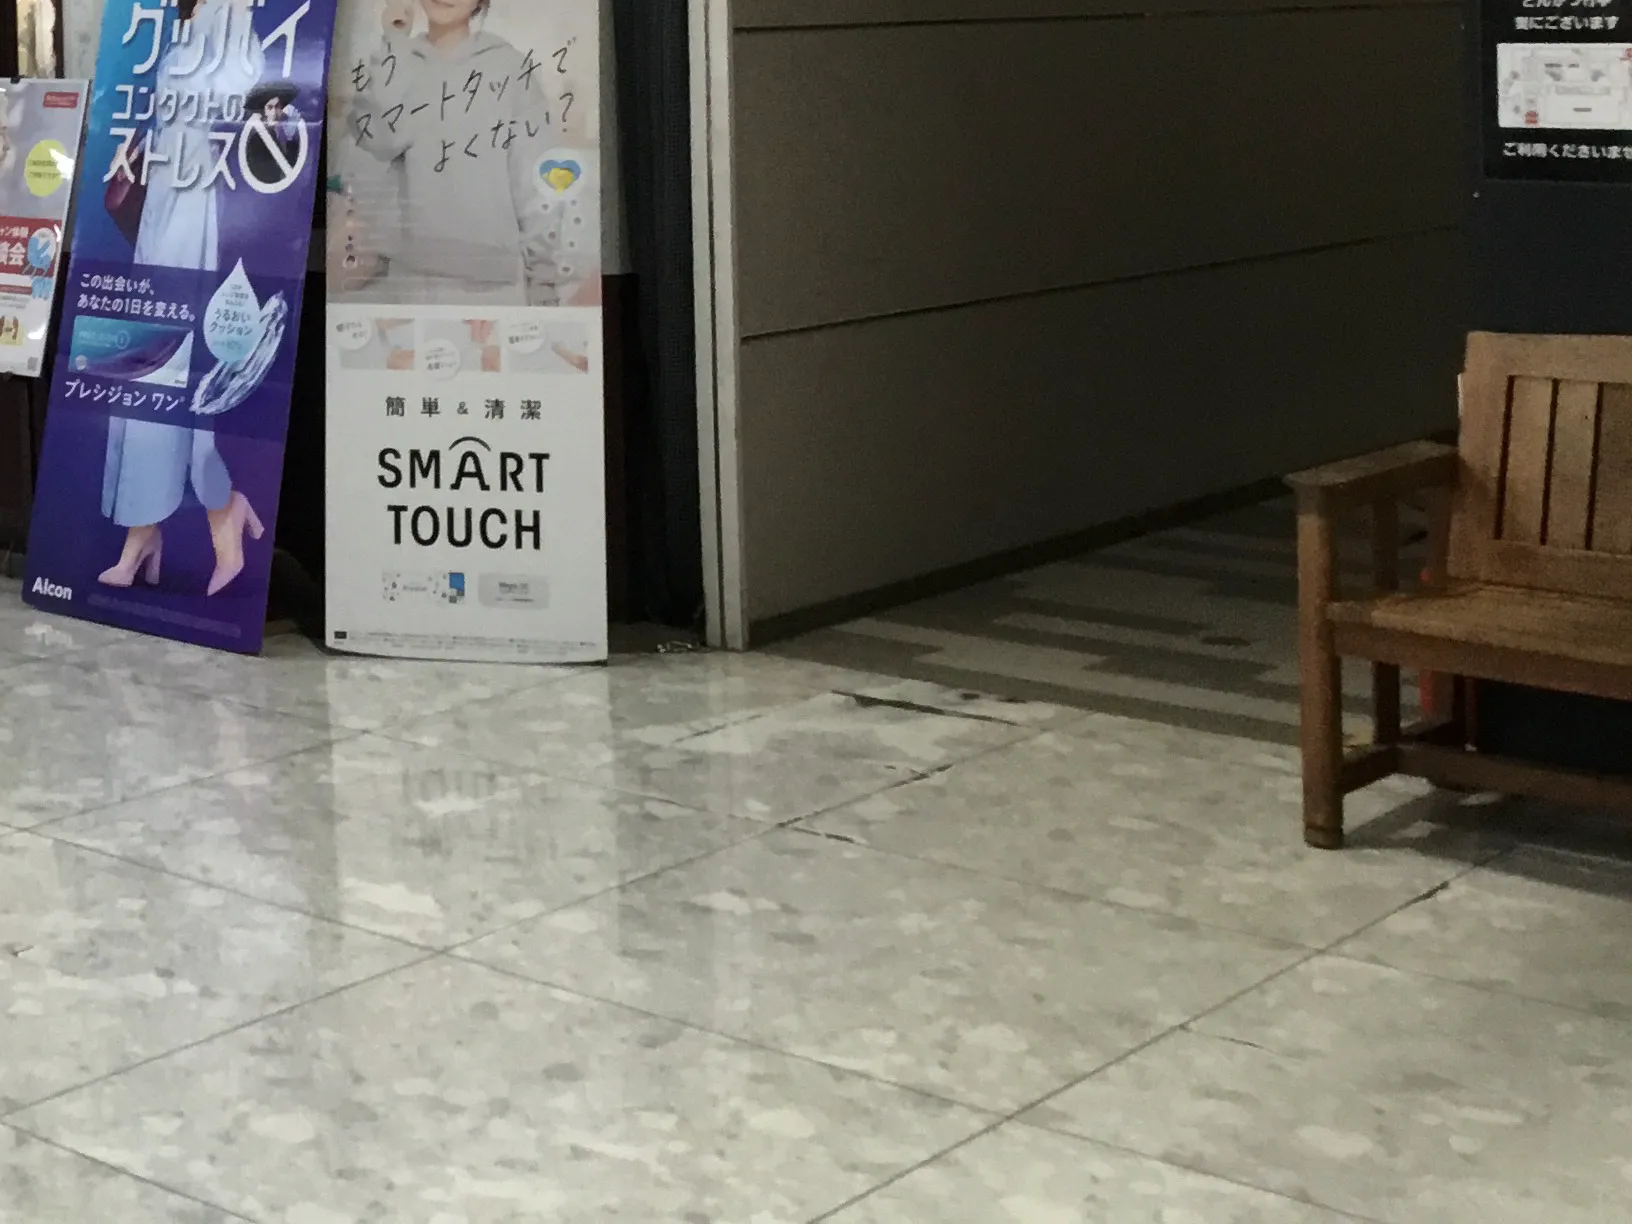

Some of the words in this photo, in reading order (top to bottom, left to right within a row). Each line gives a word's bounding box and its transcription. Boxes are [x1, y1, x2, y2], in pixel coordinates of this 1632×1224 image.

[111, 85, 246, 124] コンタクトの
[103, 127, 236, 190] ストレス
[80, 274, 156, 296] この出会いが、
[76, 293, 196, 321] あなたの1日を変える。
[65, 379, 147, 407] プレシジョン
[377, 437, 550, 493] SMART
[387, 504, 542, 551] TOUCH
[32, 576, 72, 601] Alcon
